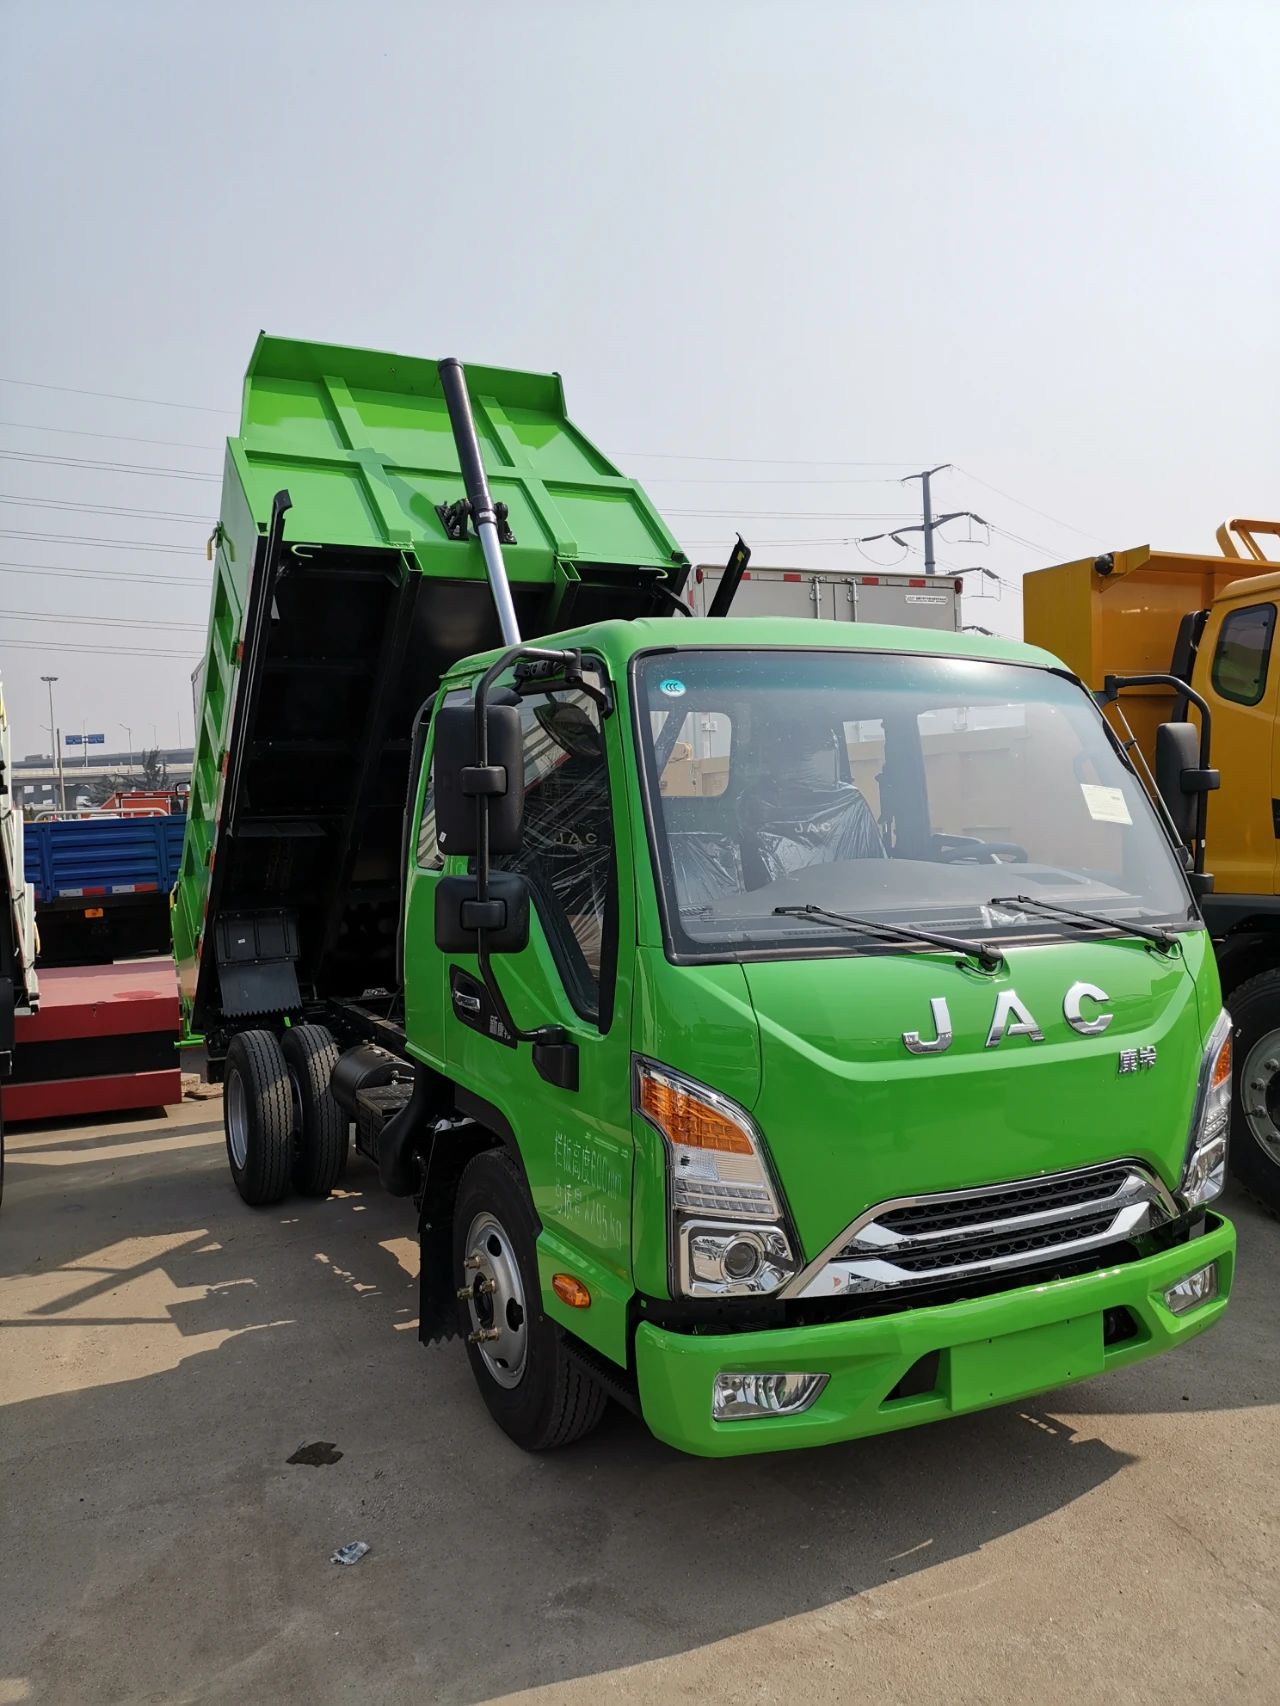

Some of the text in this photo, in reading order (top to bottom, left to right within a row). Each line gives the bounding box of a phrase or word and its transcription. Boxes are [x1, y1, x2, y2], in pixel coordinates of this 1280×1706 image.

[794, 822, 832, 833] JAC
[553, 832, 598, 845] JAC
[902, 980, 1114, 1055] JAC
